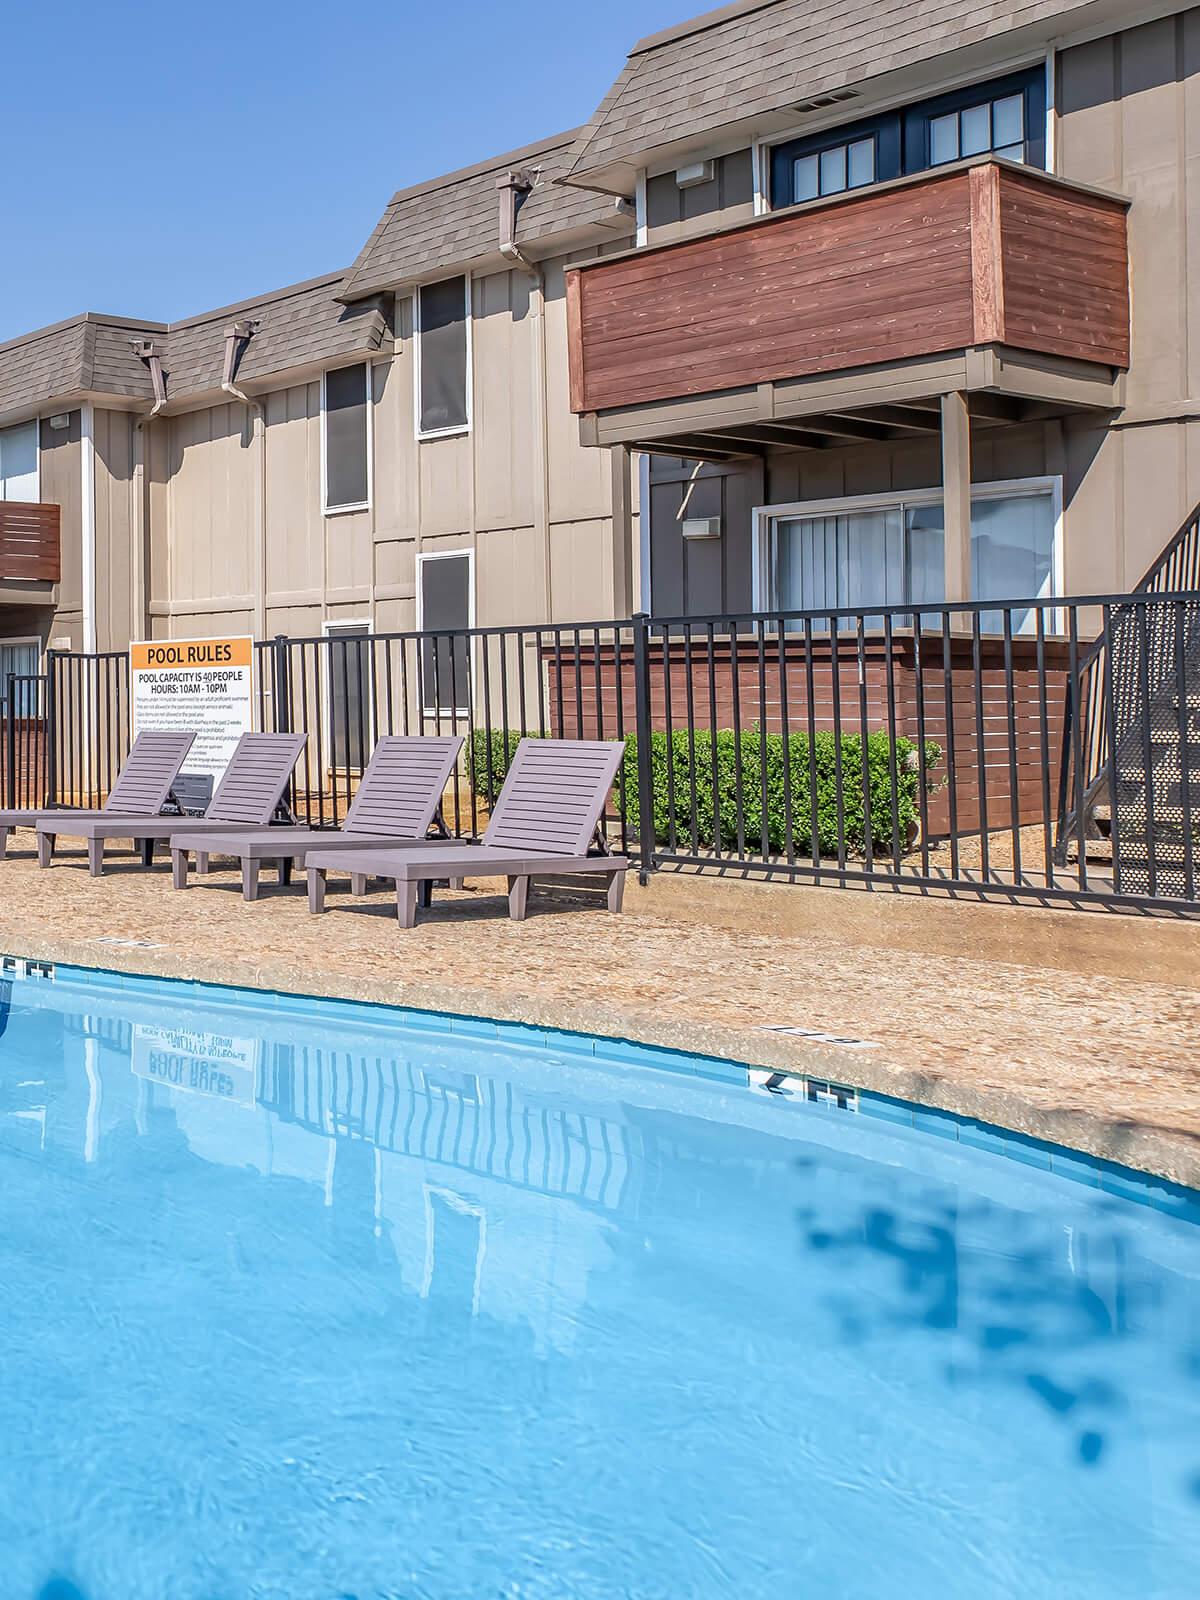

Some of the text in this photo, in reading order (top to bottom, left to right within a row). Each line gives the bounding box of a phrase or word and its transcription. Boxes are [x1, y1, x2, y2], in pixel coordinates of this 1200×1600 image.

[148, 644, 232, 664] POOL RULES
[139, 671, 243, 683] POOL CAPACITY IS 40 PEOPLE
[151, 684, 179, 694] HOURS:
[180, 684, 200, 694] 10AM
[206, 683, 227, 693] 10PM
[26, 961, 53, 979] FT
[807, 1080, 855, 1110] FT
